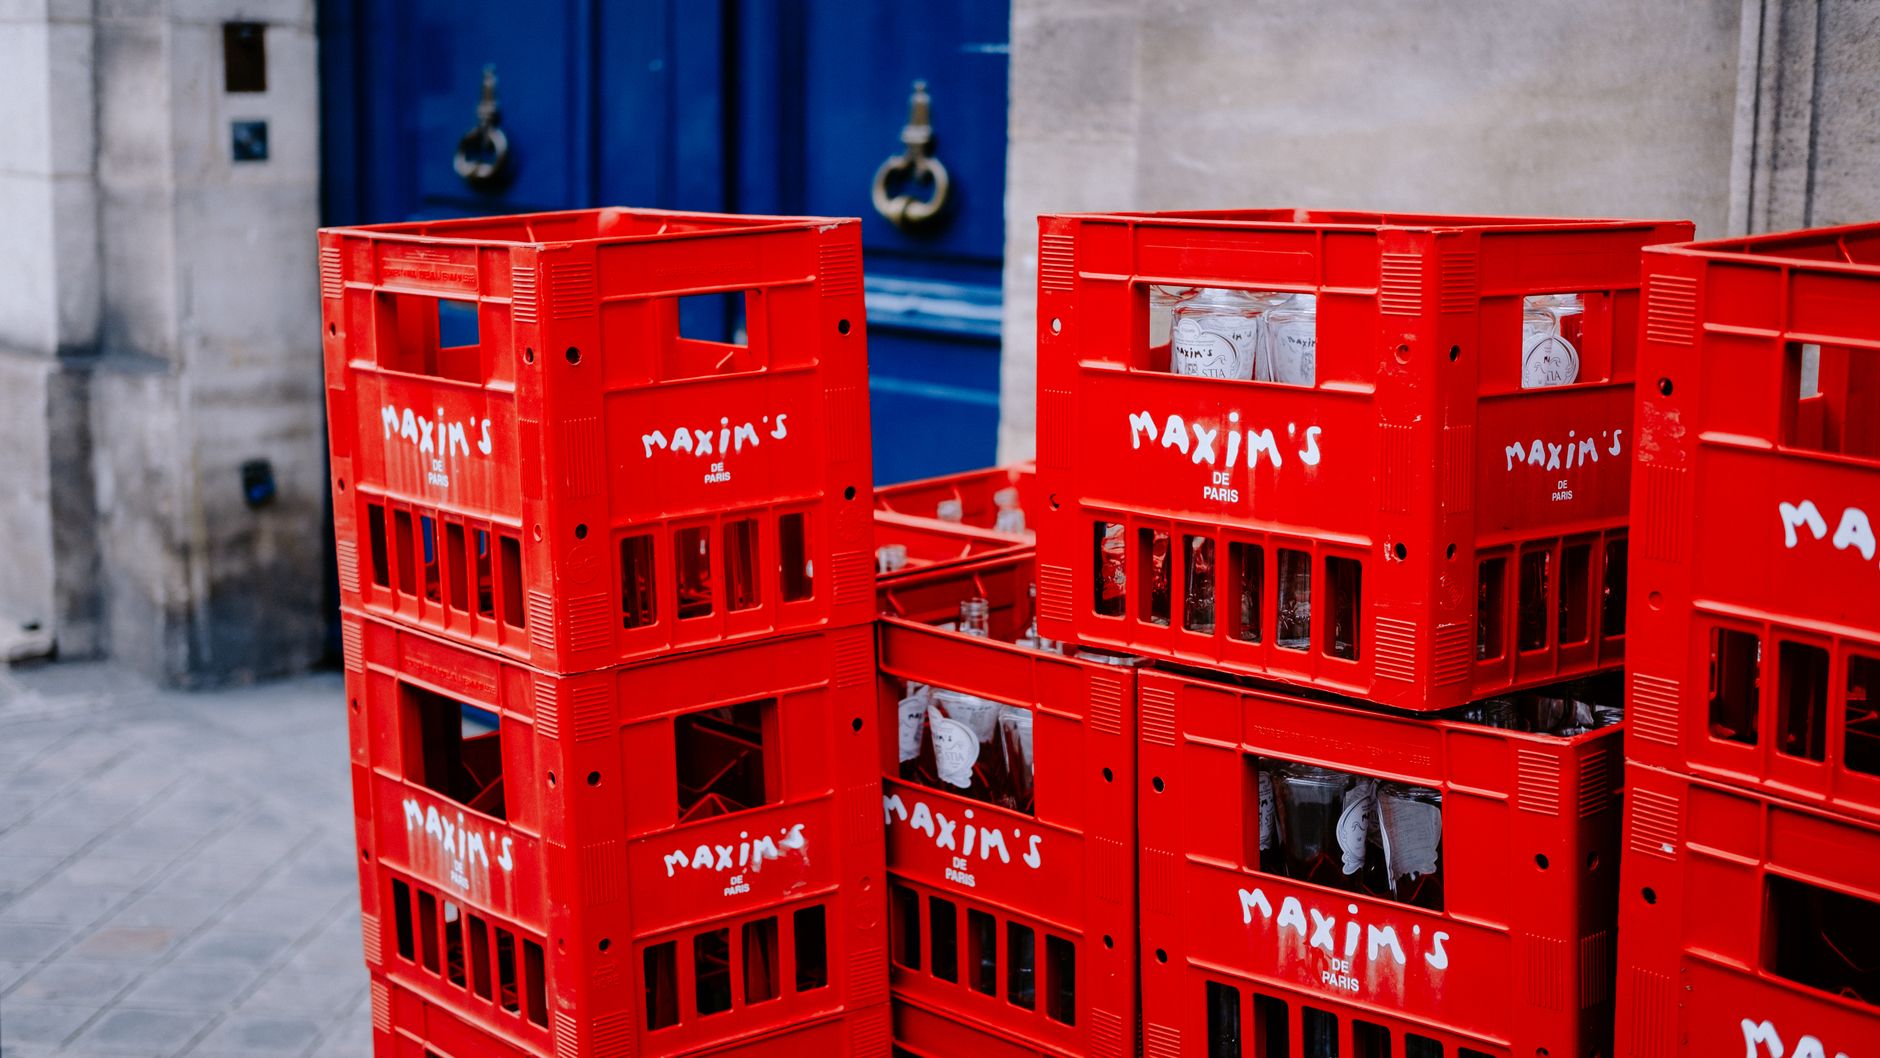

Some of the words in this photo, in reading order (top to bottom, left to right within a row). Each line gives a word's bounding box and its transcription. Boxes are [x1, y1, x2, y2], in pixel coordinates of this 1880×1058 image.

[432, 459, 445, 472] DE
[710, 462, 724, 473] DE
[428, 472, 449, 488] PARIS
[704, 472, 731, 484] PARIS
[1212, 471, 1230, 486] DE
[1557, 480, 1568, 490] DE
[1203, 485, 1239, 502] PARIS
[1552, 489, 1573, 501] PARIS
[953, 856, 967, 871] DE
[730, 875, 743, 885] DE
[945, 867, 976, 888] PARIS
[723, 883, 750, 896] PARIS
[1331, 957, 1350, 974] DE
[1322, 970, 1360, 992] PARIS
